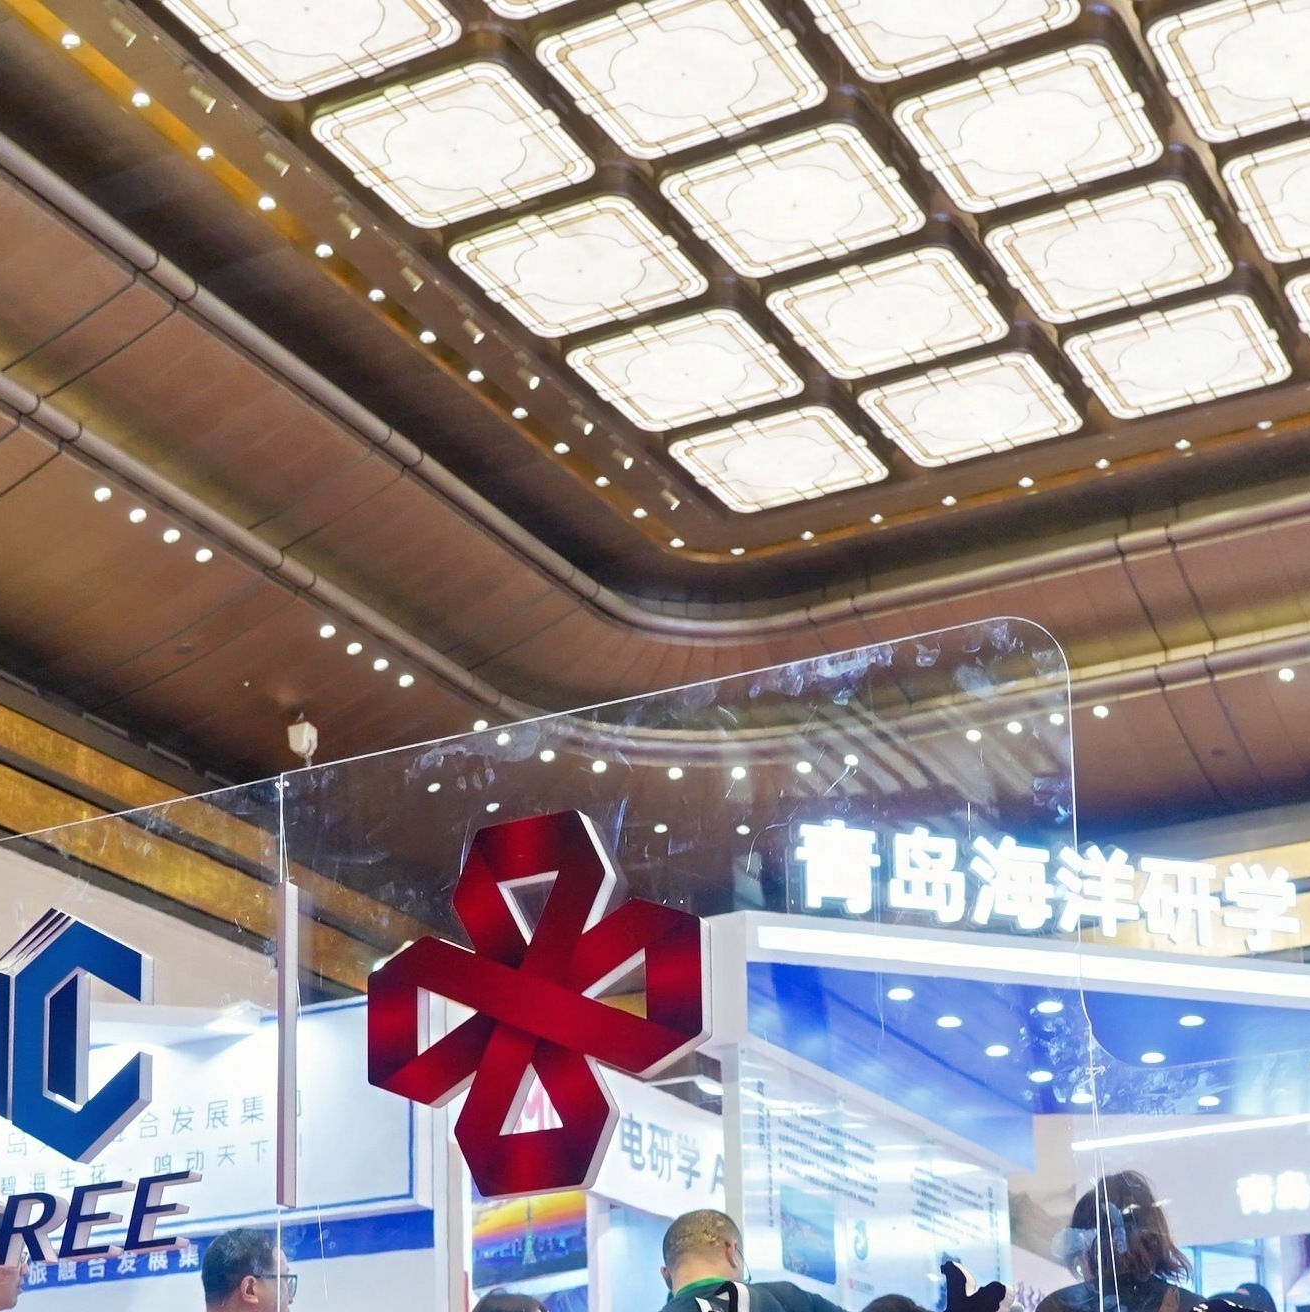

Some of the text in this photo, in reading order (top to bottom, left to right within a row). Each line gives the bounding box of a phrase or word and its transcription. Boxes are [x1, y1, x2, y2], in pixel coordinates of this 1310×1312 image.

[796, 819, 1300, 952] 青岛海洋研学
